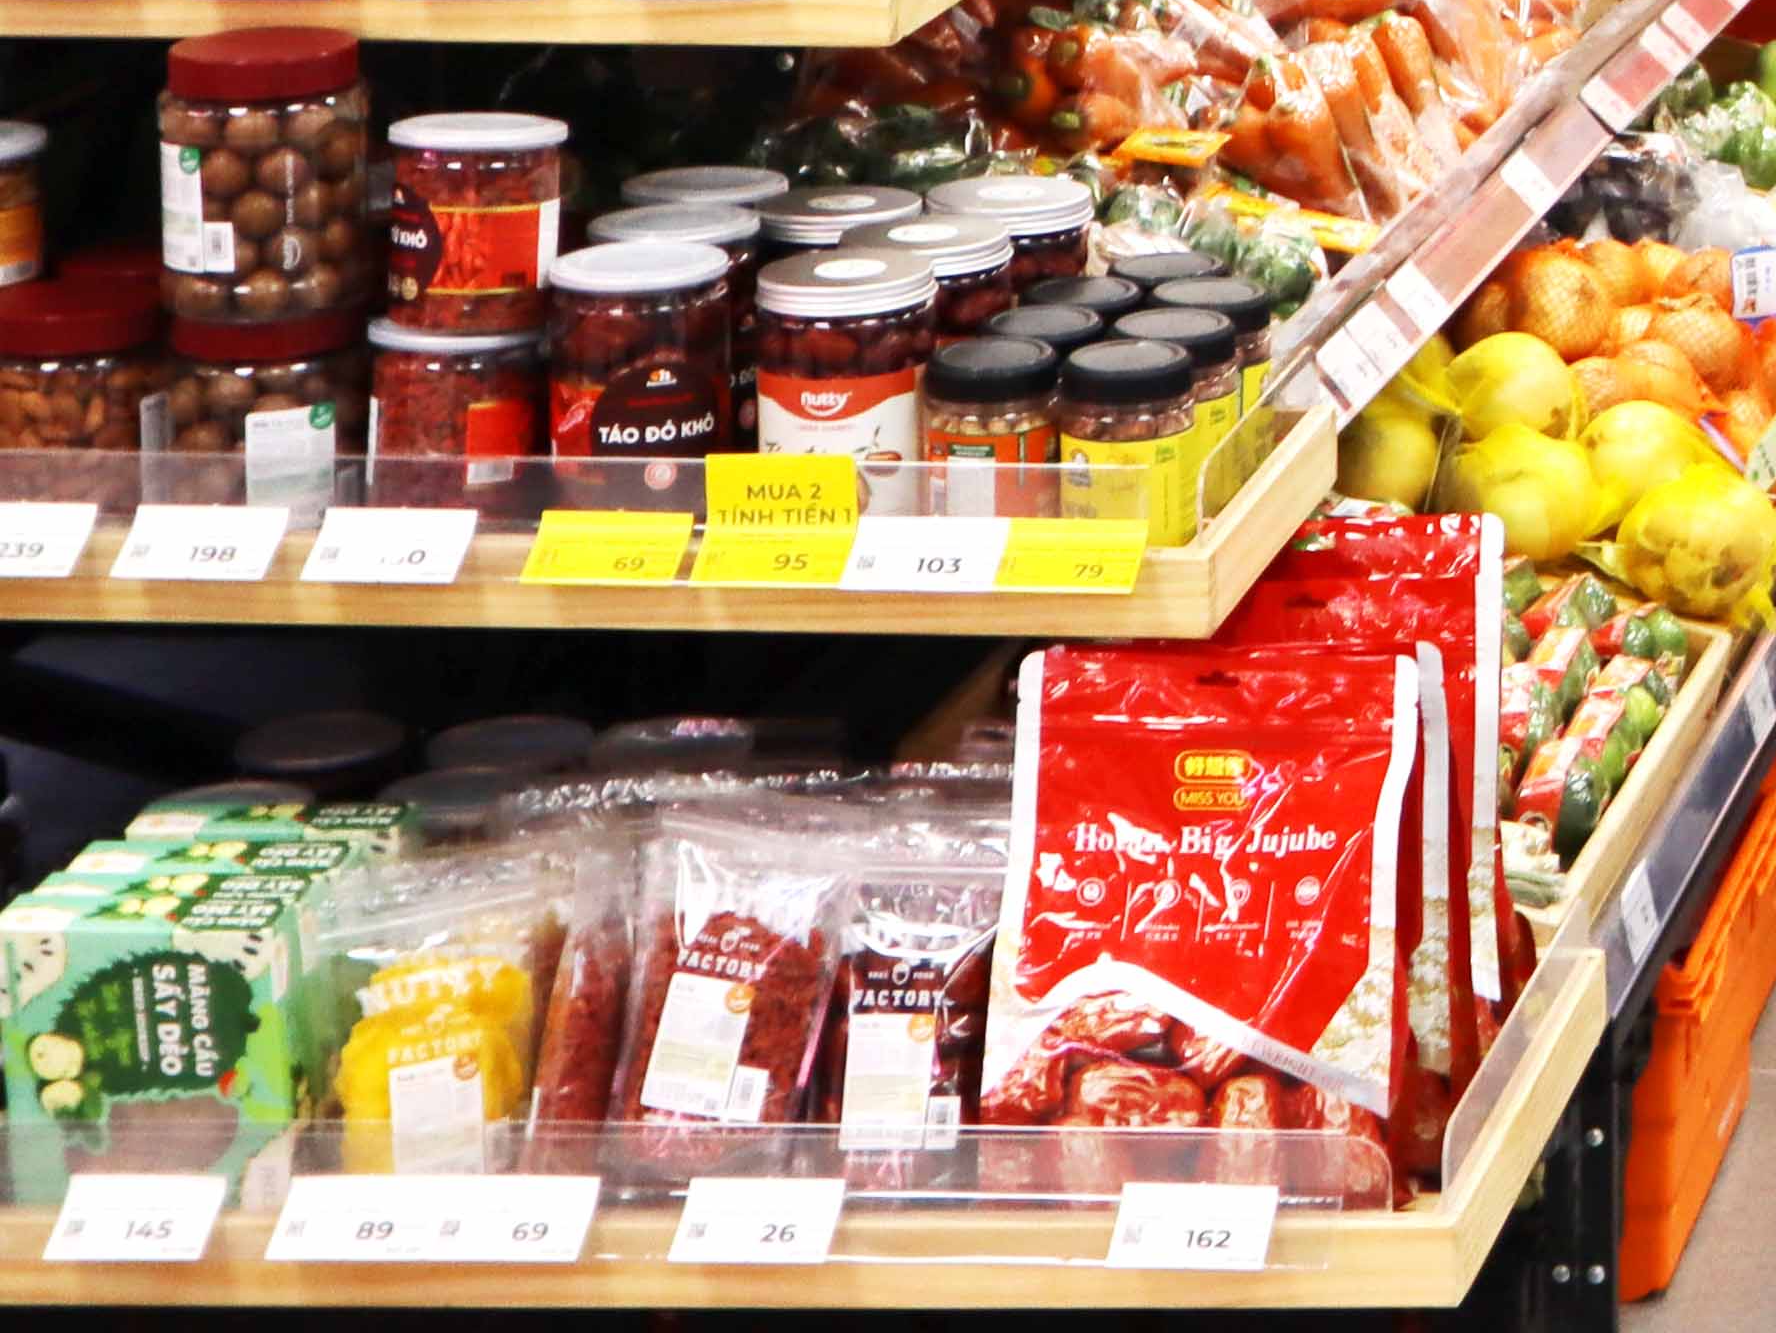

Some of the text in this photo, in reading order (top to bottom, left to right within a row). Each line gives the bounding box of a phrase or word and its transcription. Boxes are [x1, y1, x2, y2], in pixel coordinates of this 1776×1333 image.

[600, 413, 715, 446] TÁO ĐỎ KHÔ
[747, 483, 822, 501] MUA 2
[717, 503, 853, 526] TÍNH TIỀN 1
[188, 544, 237, 564] 198
[612, 555, 646, 572] 69
[772, 553, 809, 571] 95
[915, 557, 962, 575] 103
[1073, 563, 1104, 579] 79
[1180, 791, 1246, 805] MISS YOU
[1180, 824, 1337, 861] Big Jujube
[675, 949, 767, 980] FACTORY
[853, 990, 945, 1008] FACTORY
[124, 1218, 173, 1240] 145
[355, 1219, 394, 1241] 89
[511, 1220, 549, 1242] 69
[760, 1223, 797, 1243] 26
[1183, 1229, 1233, 1249] 162
